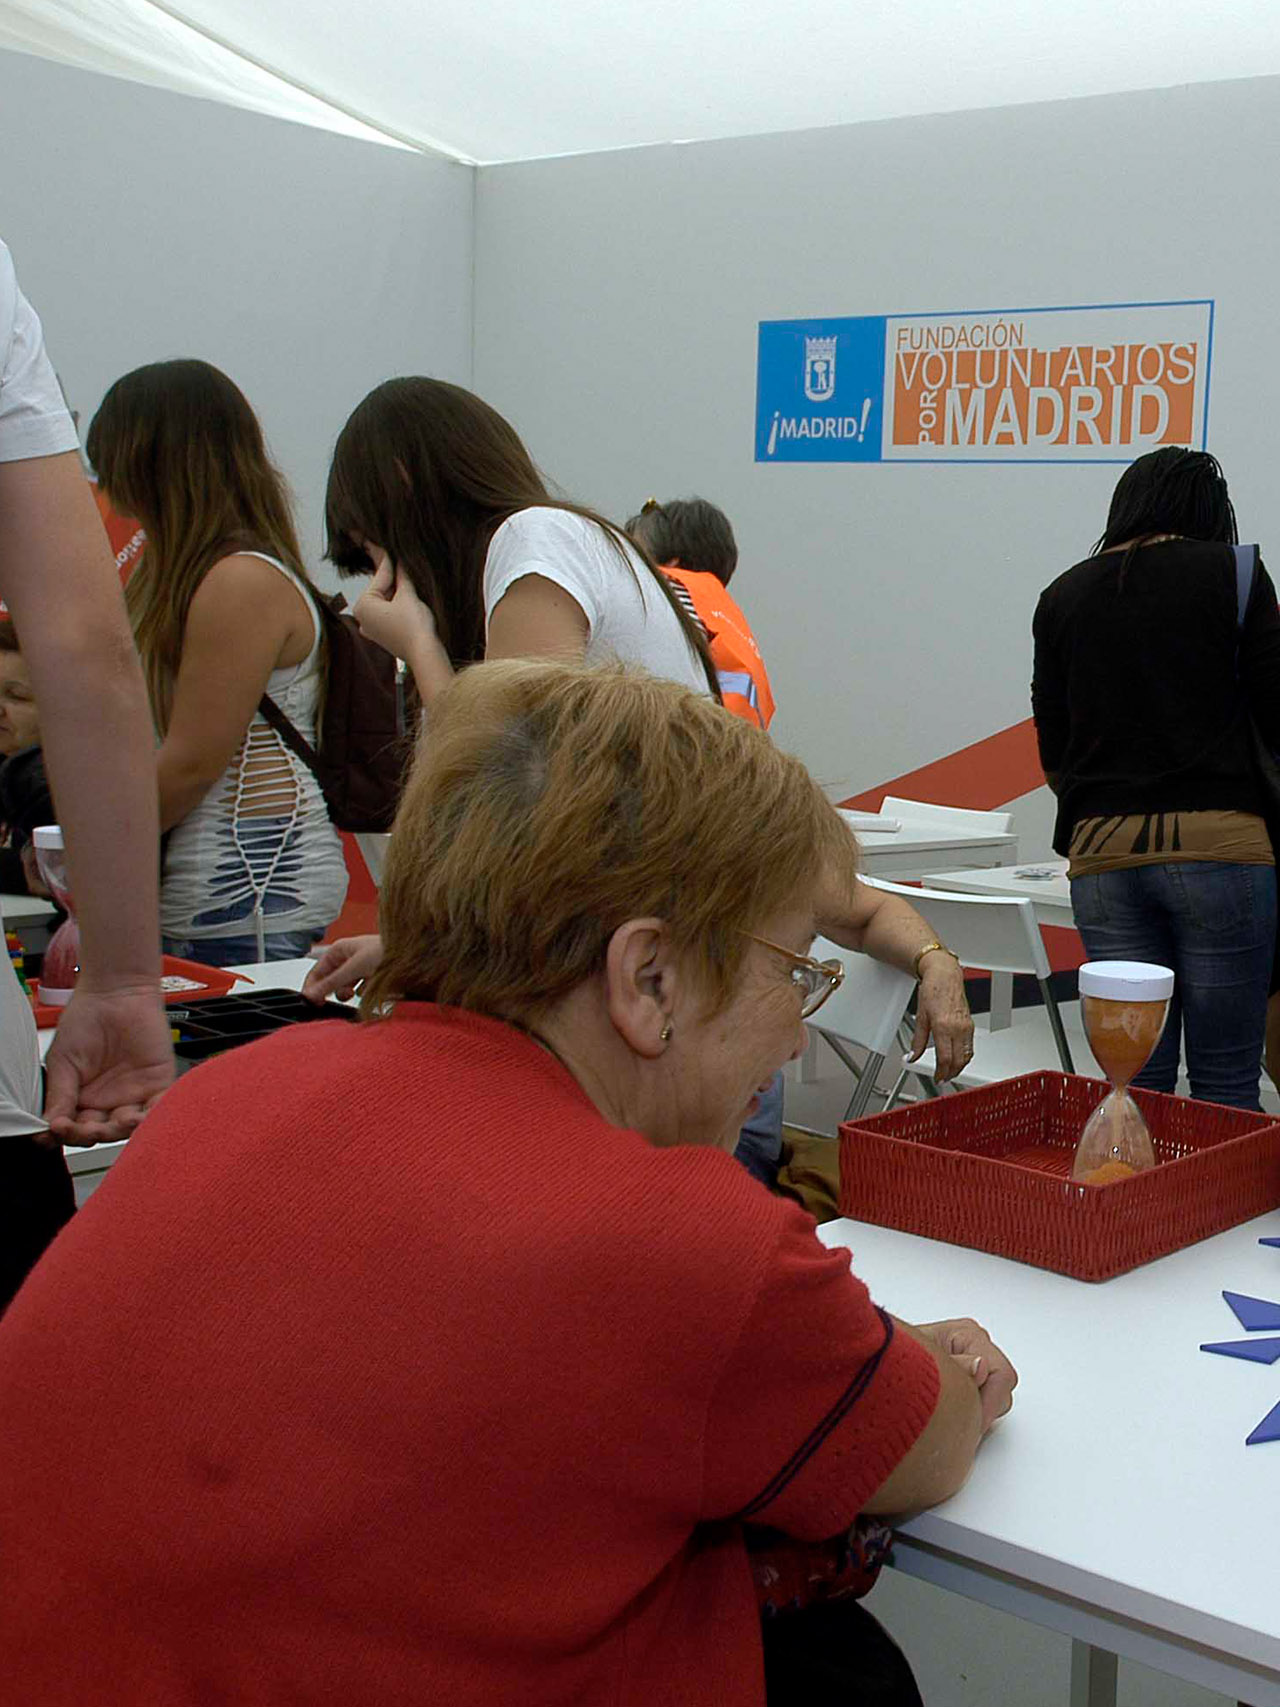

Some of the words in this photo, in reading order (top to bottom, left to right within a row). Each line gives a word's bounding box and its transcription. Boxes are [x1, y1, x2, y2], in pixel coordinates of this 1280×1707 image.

[896, 318, 1024, 351] FUNDACIÓN
[898, 342, 1195, 390] VOLUNTARIOS
[918, 390, 938, 445] POR
[943, 383, 1170, 445] MADRID
